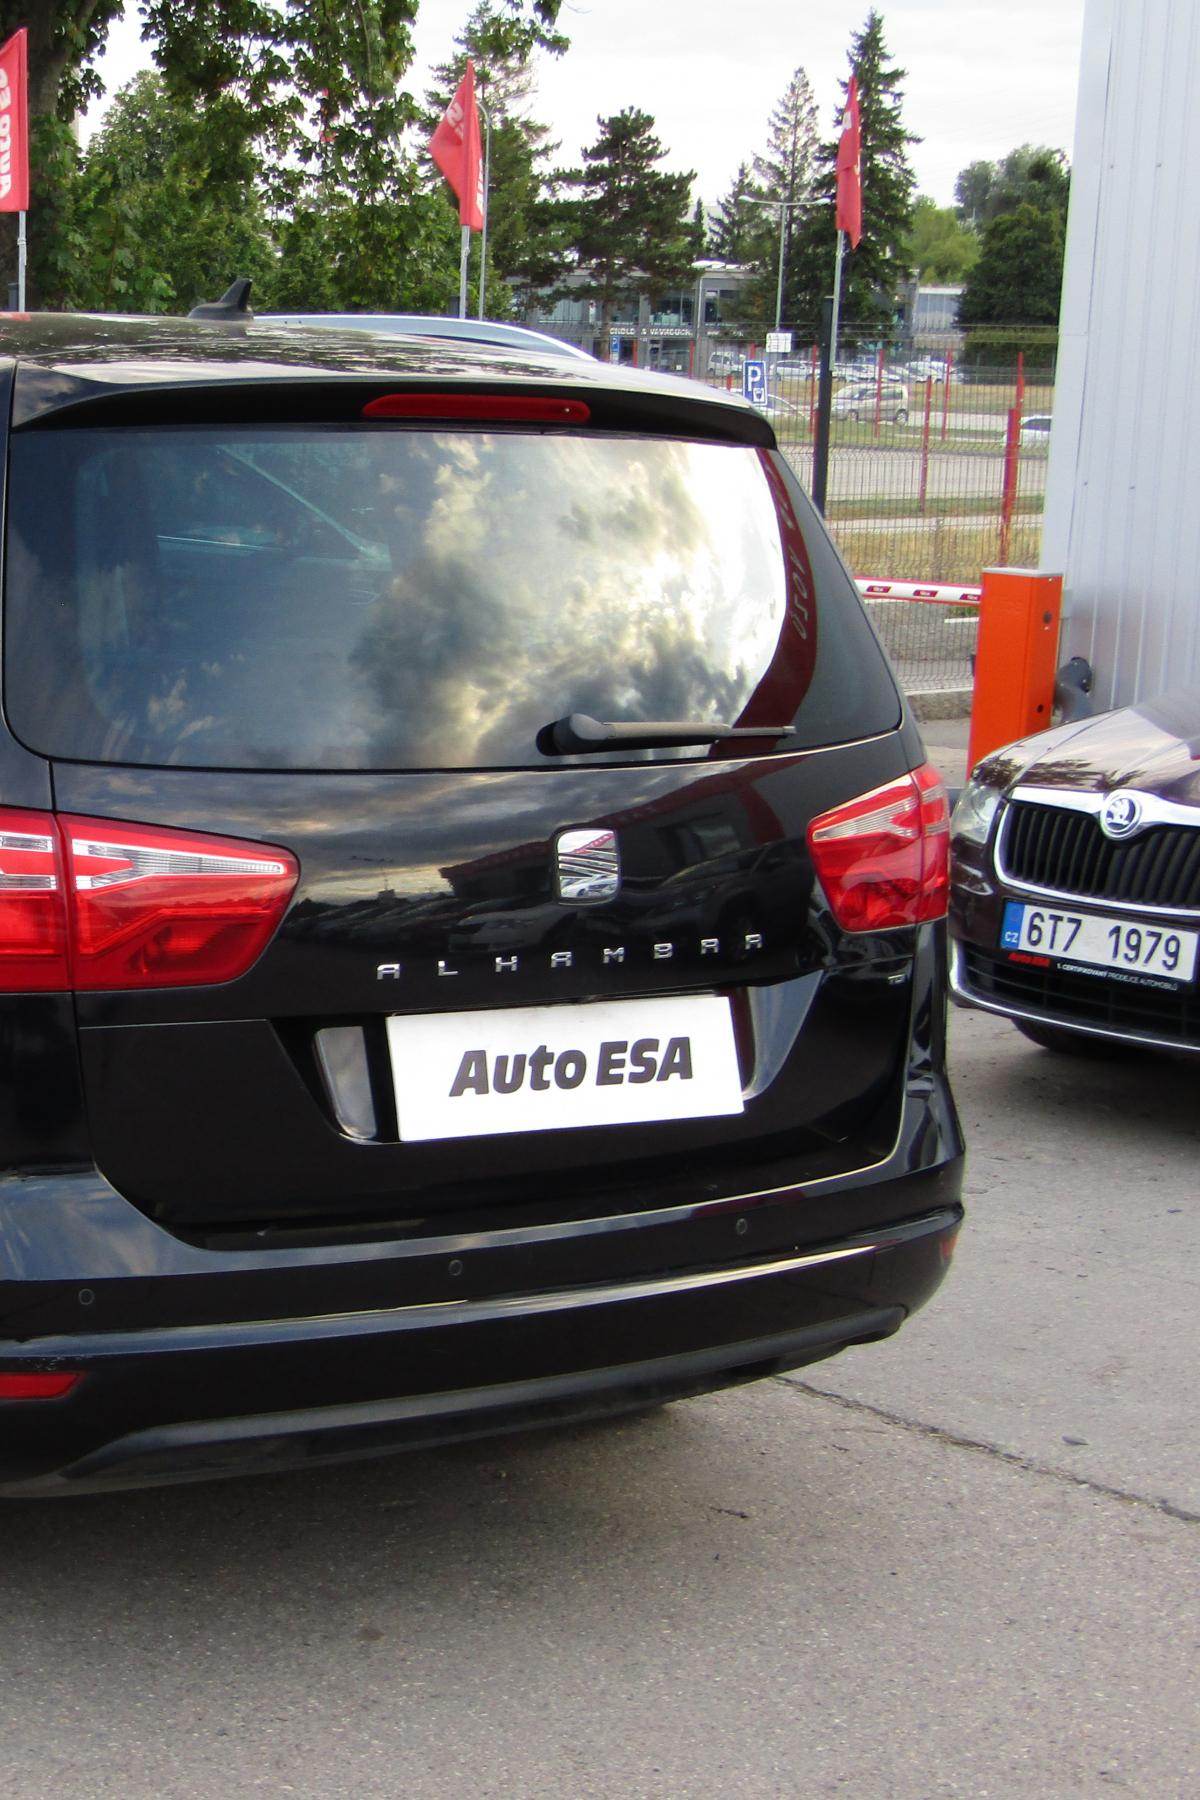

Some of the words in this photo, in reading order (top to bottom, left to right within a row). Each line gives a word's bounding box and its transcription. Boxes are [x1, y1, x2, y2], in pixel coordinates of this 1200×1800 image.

[747, 365, 762, 392] P
[376, 933, 763, 980] ALHAMBRA
[1004, 931, 1019, 944] CZ
[1027, 911, 1083, 953] 6T7
[1108, 925, 1181, 972] 1979
[449, 1045, 587, 1098] Auto
[595, 1036, 693, 1087] ESA
